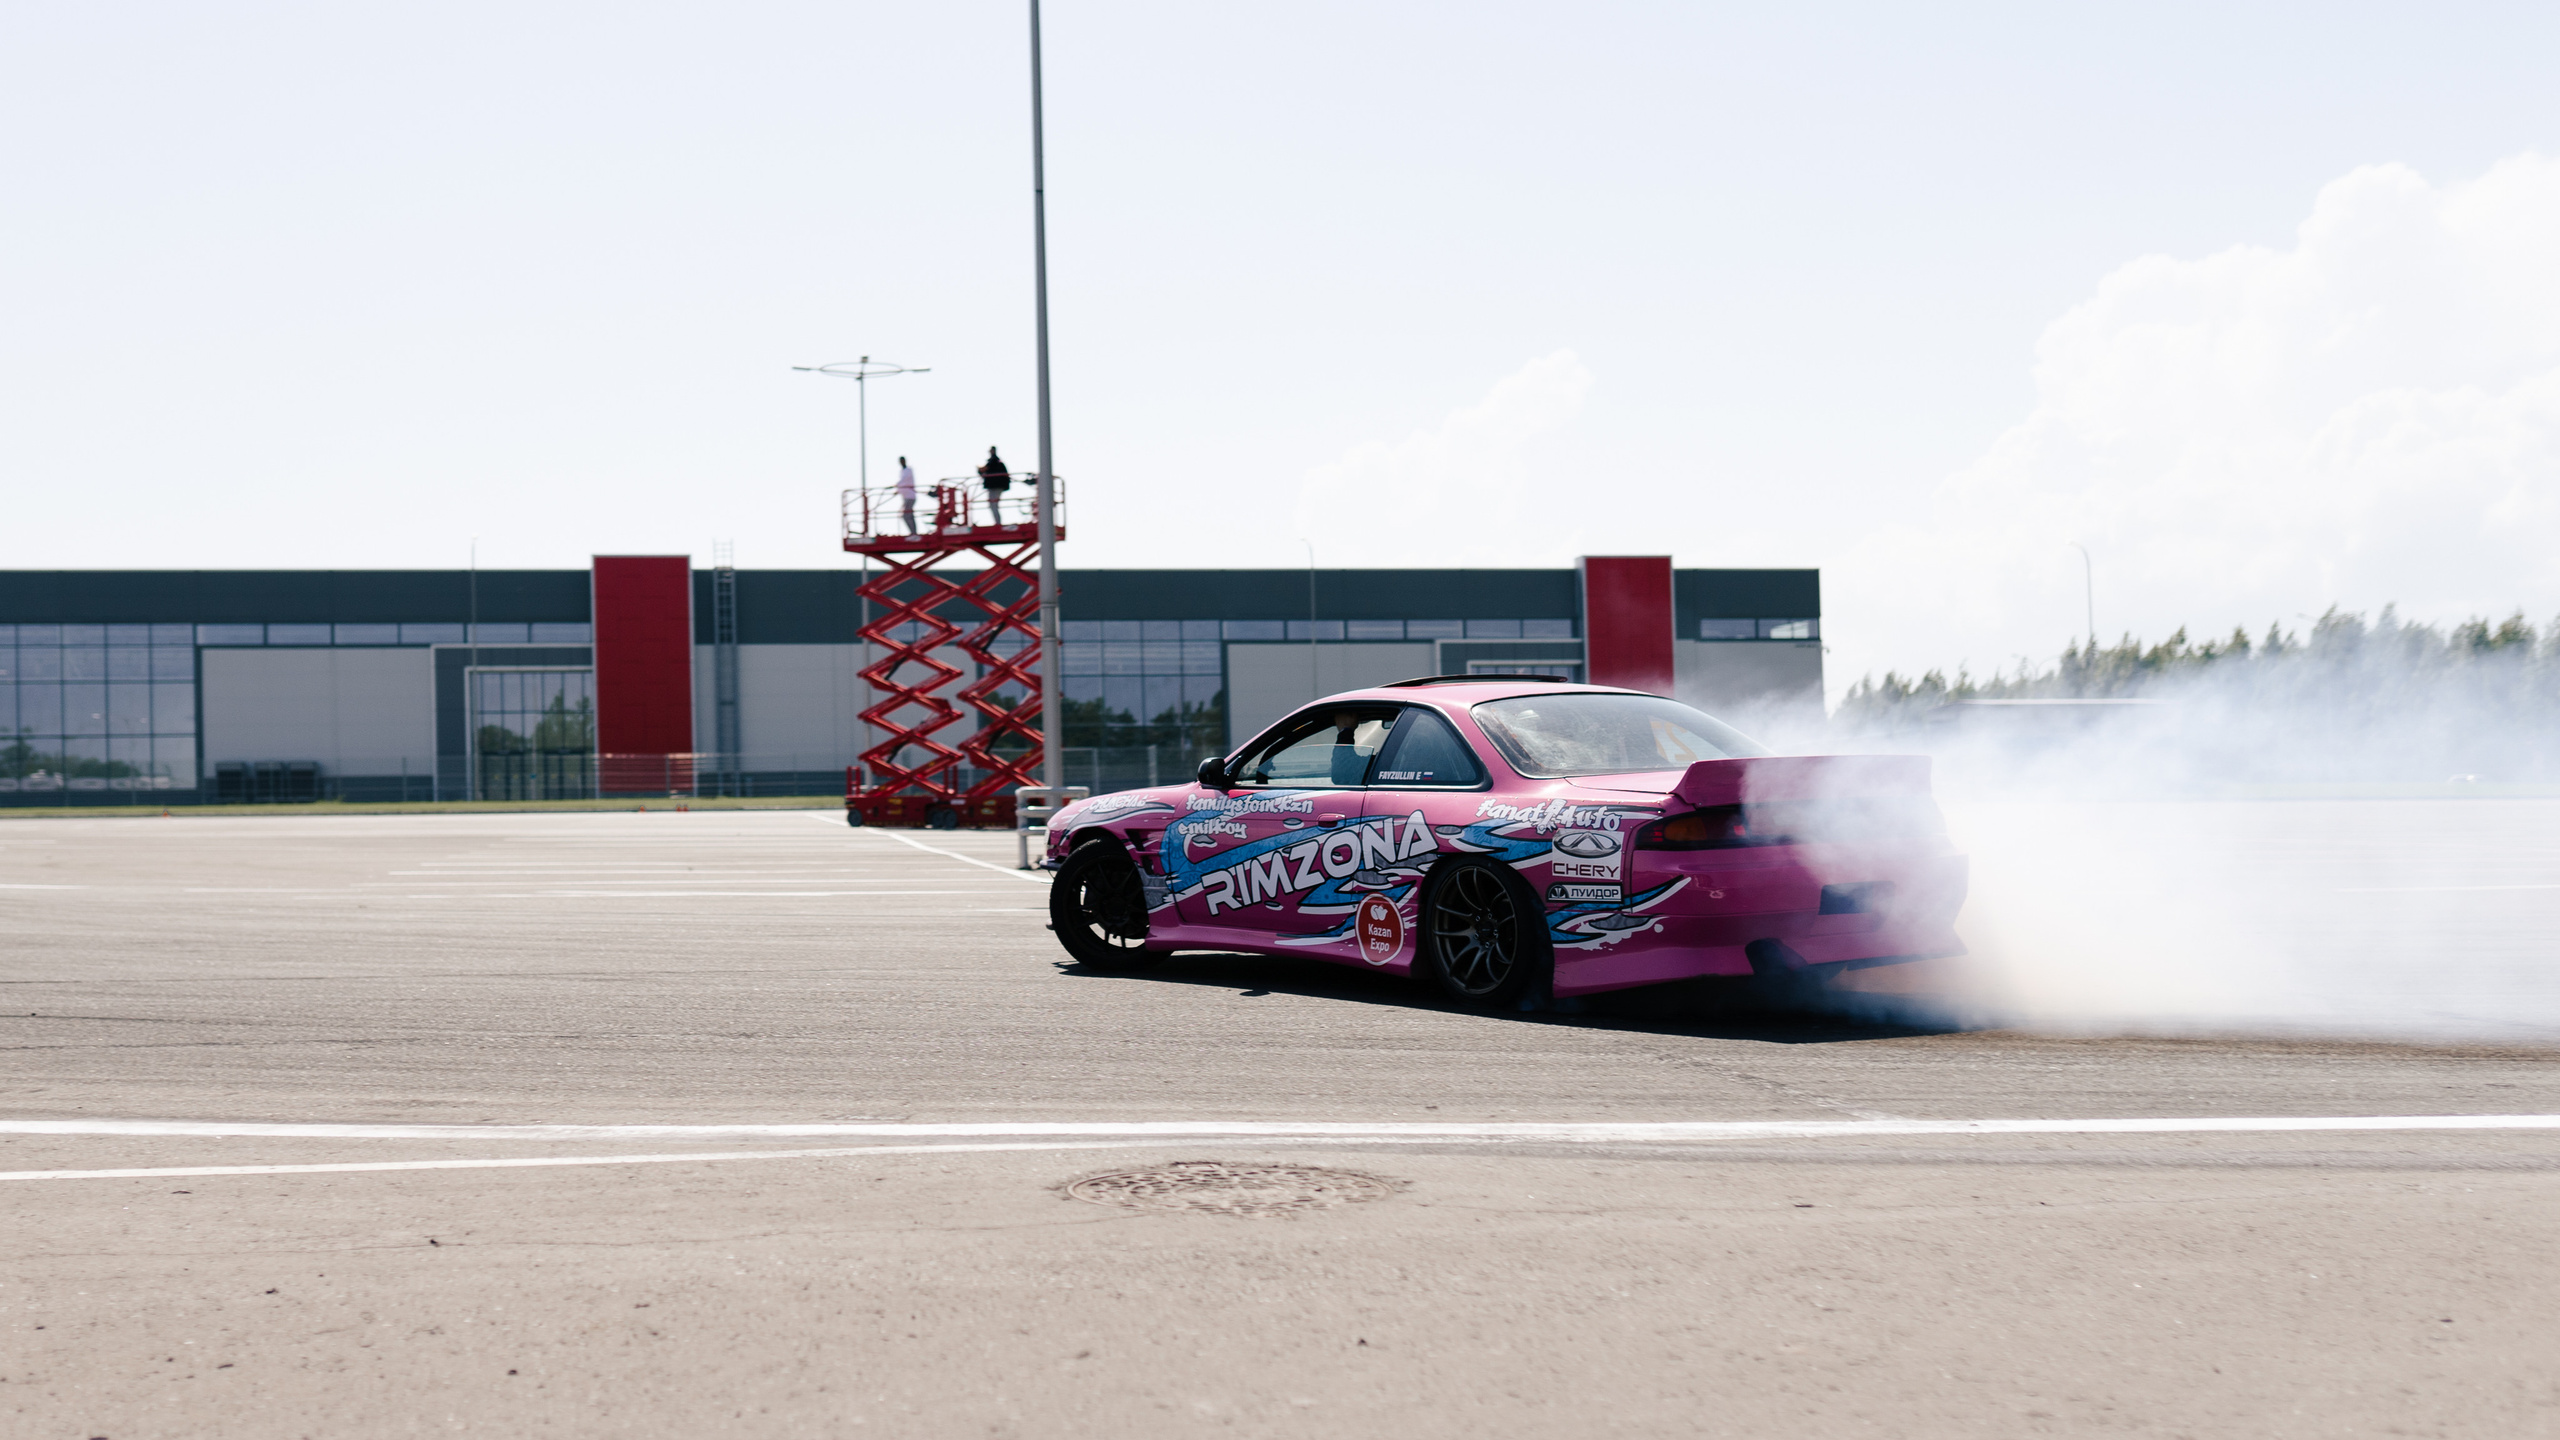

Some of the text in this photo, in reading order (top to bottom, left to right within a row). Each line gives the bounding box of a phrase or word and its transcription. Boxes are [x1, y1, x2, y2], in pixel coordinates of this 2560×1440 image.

[1378, 770, 1422, 780] FAYZULLIN E
[1201, 809, 1439, 916] RIMZONA
[1553, 862, 1619, 878] CHERY
[1571, 887, 1619, 899] ЛУИДОР
[1368, 923, 1392, 938] Kazan
[1370, 938, 1390, 953] Expo
